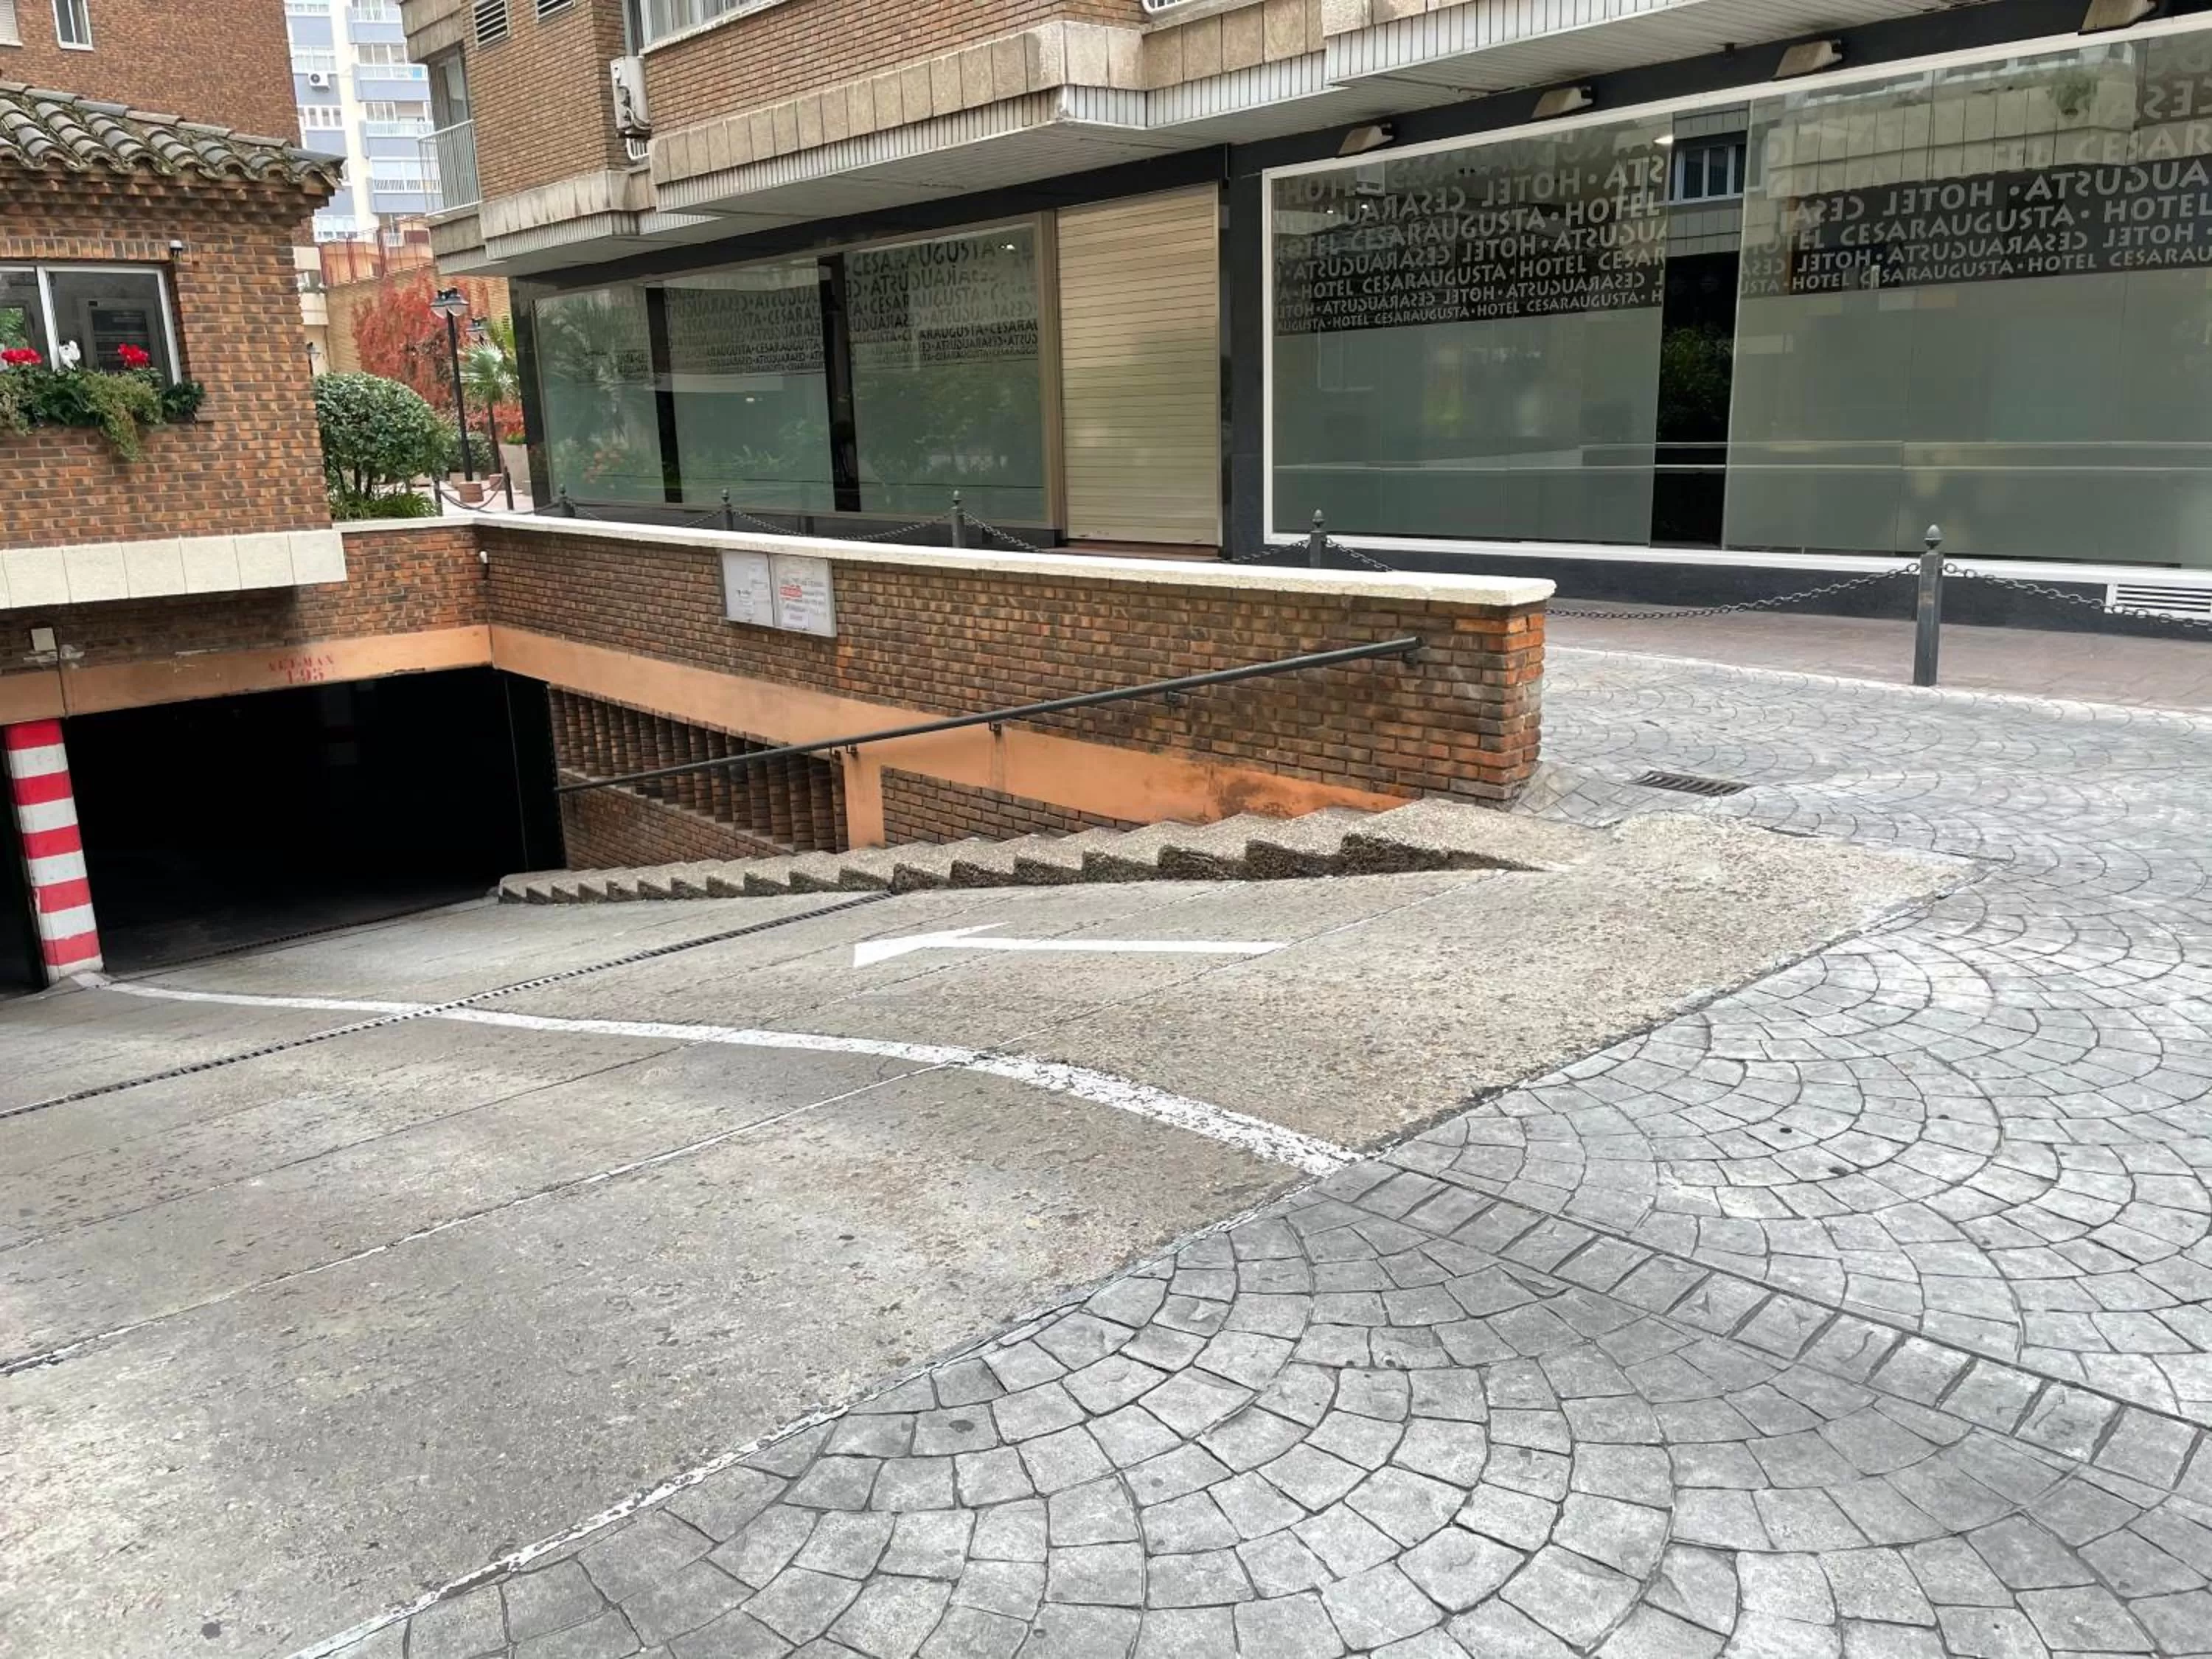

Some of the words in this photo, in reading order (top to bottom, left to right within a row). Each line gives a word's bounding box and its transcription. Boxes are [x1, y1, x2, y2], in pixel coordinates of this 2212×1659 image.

[1565, 192, 1660, 226] HOTEL
[1840, 203, 2076, 246] CESARAUGUSTA
[1301, 279, 1354, 301] HOTEL
[1362, 262, 1507, 295] CESARAUGUSTA
[1520, 254, 1587, 278] HOTEL
[1792, 272, 1850, 291] HOTEL
[1860, 259, 2014, 288] CSARAUGUSTA
[2028, 253, 2098, 272] HOTEL
[1477, 302, 1520, 316] HOTEL
[1526, 291, 1639, 313] CESARAUGUSTA
